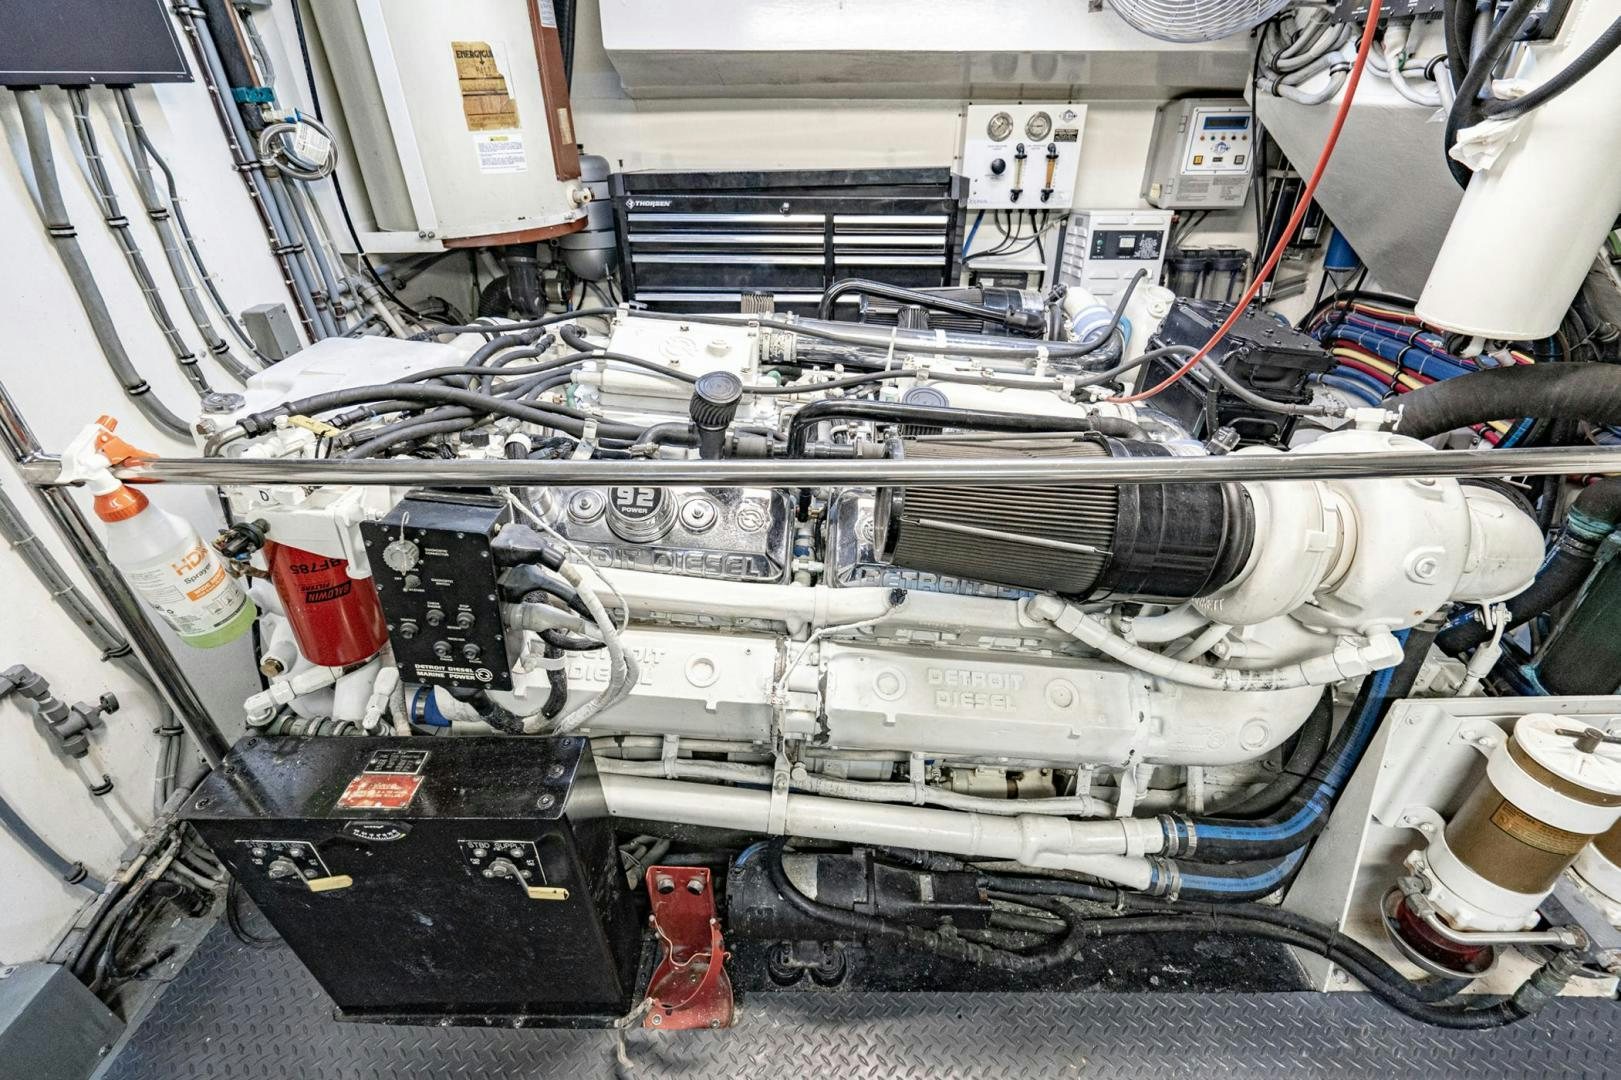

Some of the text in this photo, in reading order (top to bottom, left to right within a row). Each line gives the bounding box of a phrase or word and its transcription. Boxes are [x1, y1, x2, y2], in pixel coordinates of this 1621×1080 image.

[635, 199, 672, 208] THORSEN
[616, 487, 655, 507] 92
[621, 506, 648, 514] POWER
[652, 549, 761, 578] DIESEL
[308, 583, 350, 602] BALDWIN
[414, 663, 446, 671] DETROIT
[416, 671, 476, 681] MARINE POWER
[926, 667, 1024, 691] DETROIT
[934, 689, 1018, 713] DIESEL
